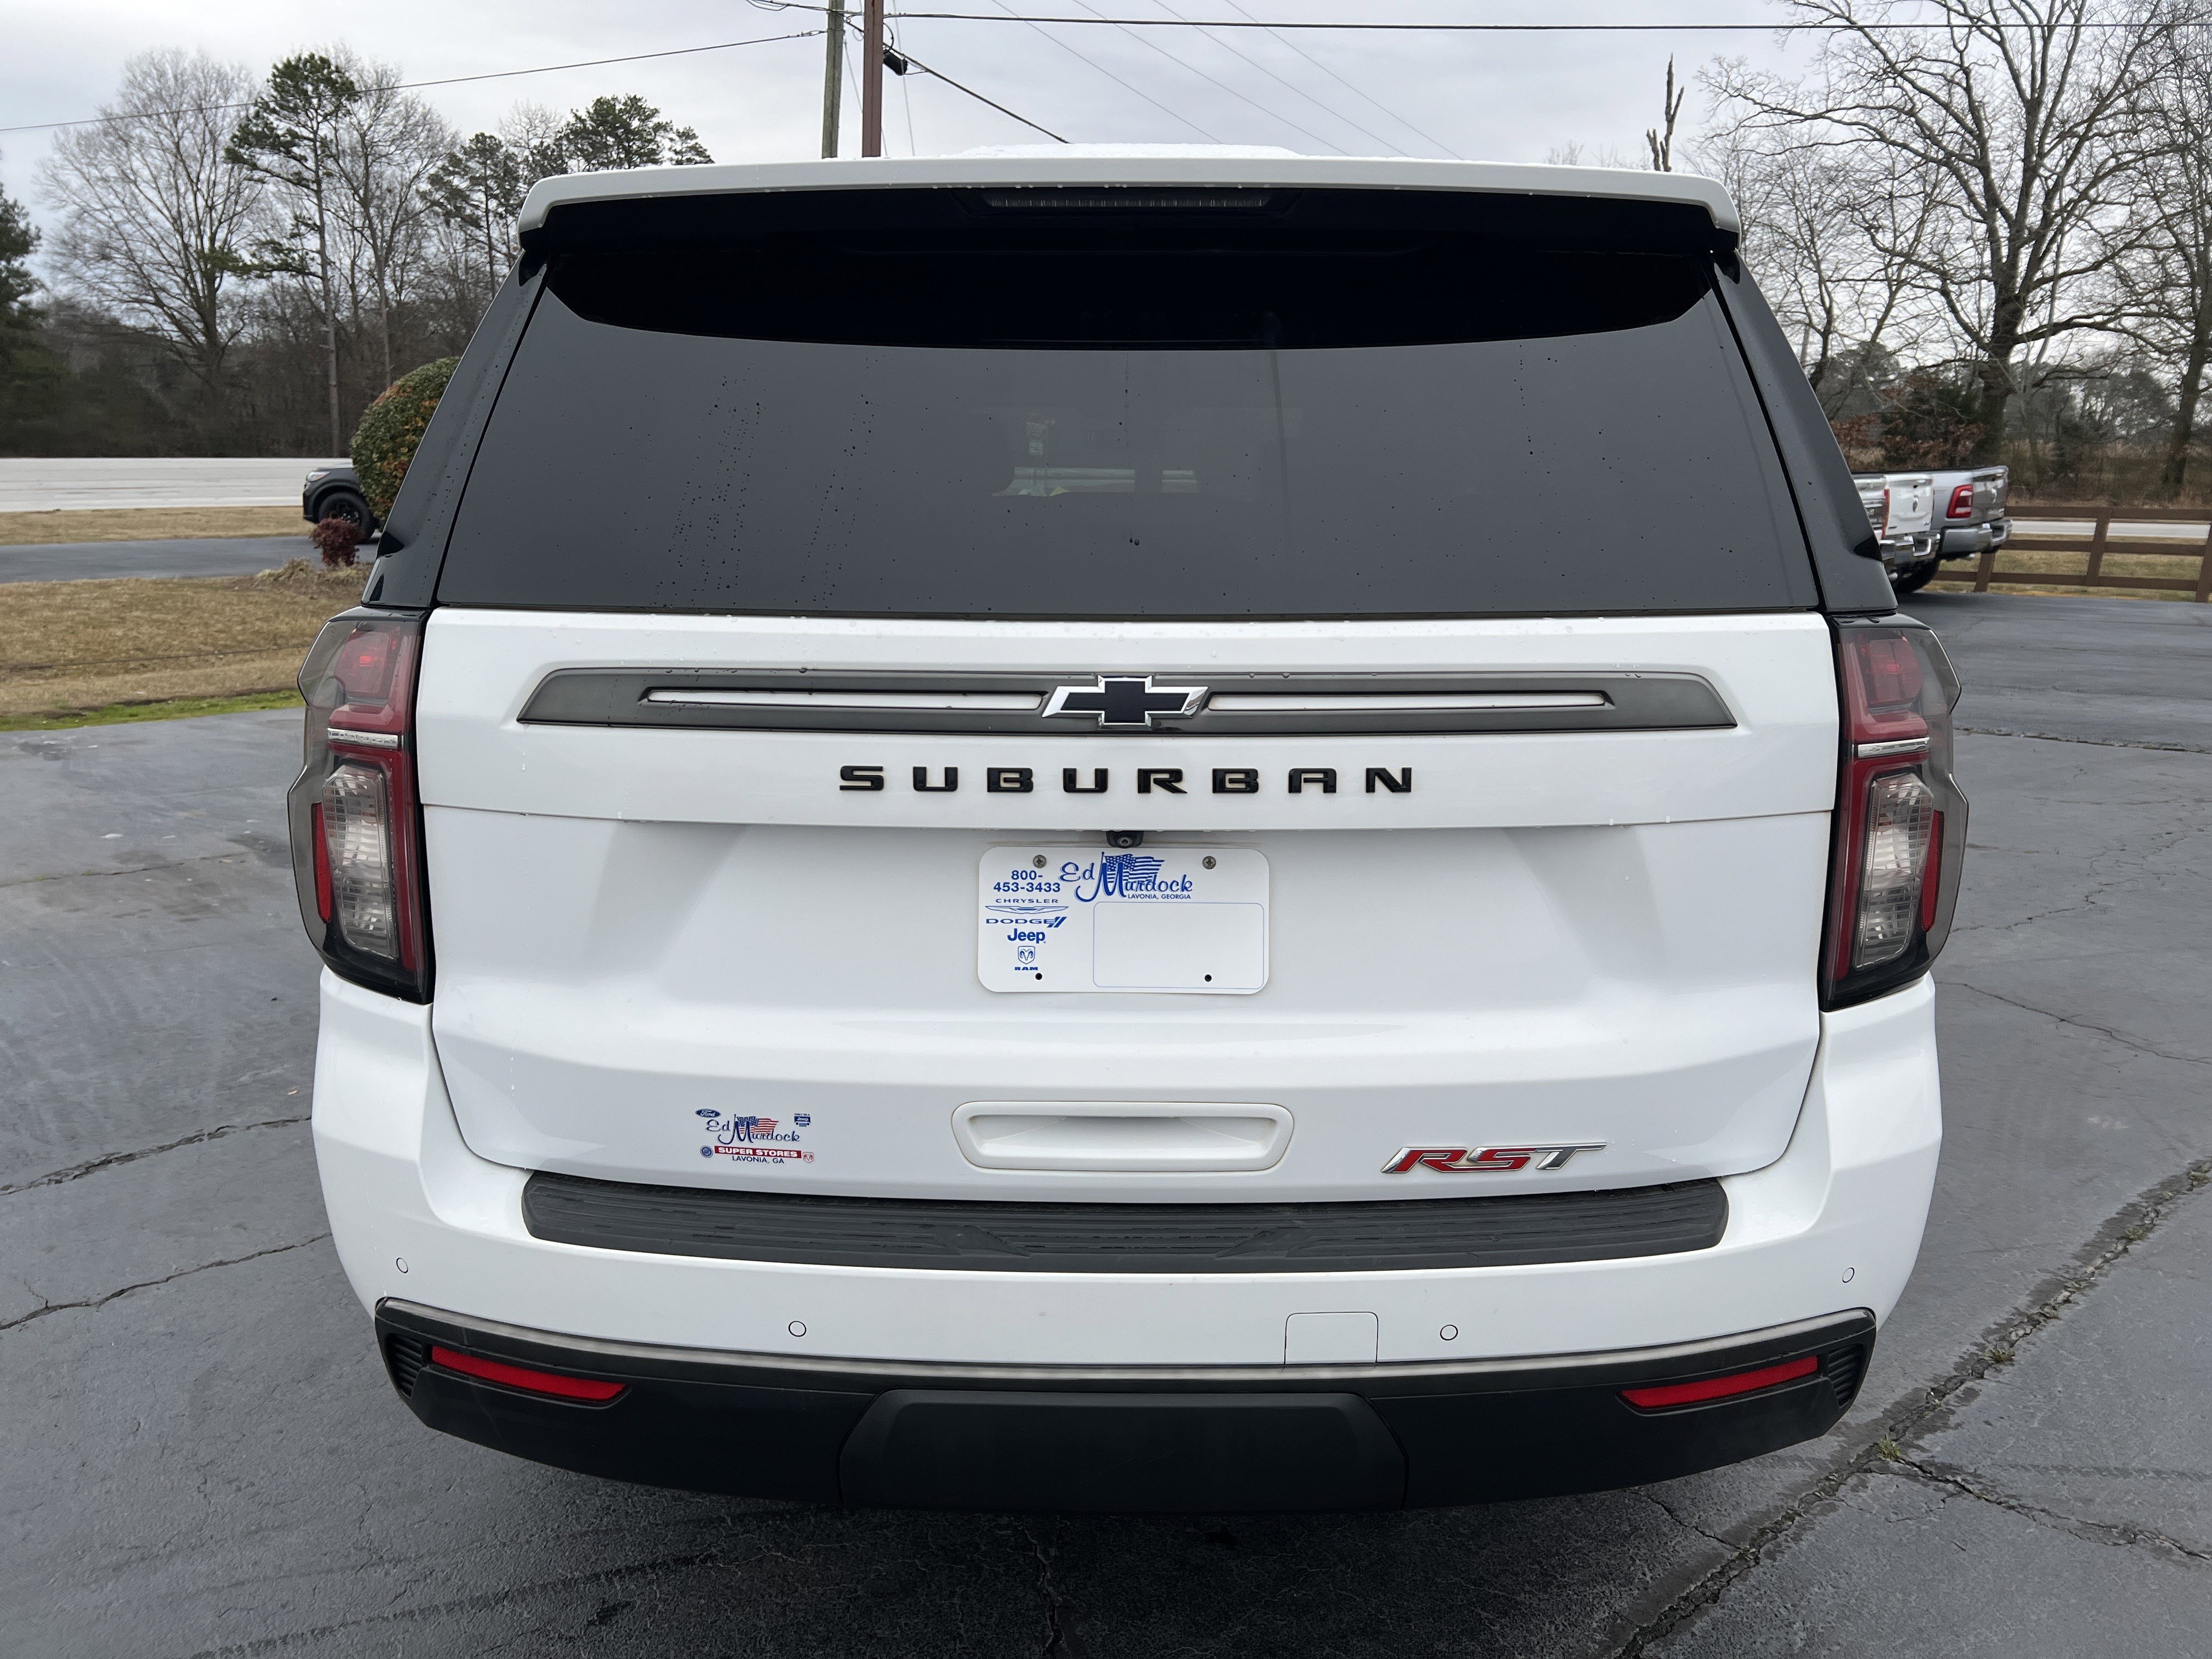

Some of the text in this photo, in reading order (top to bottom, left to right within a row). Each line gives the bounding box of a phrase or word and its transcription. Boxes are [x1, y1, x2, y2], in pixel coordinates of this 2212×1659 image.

[839, 765, 1412, 793] SUBURBAN
[1011, 870, 1043, 881] 800-
[1060, 861, 1193, 902] Ed Murdock
[993, 882, 1061, 893] 453-3433
[1007, 928, 1046, 944] Jeep
[700, 1109, 716, 1117] Ford
[706, 1119, 800, 1145] Ed Murdock
[718, 1147, 798, 1158] SUPER STORES
[1381, 1142, 1606, 1173] RST
[732, 1155, 770, 1164] LAVONIA,
